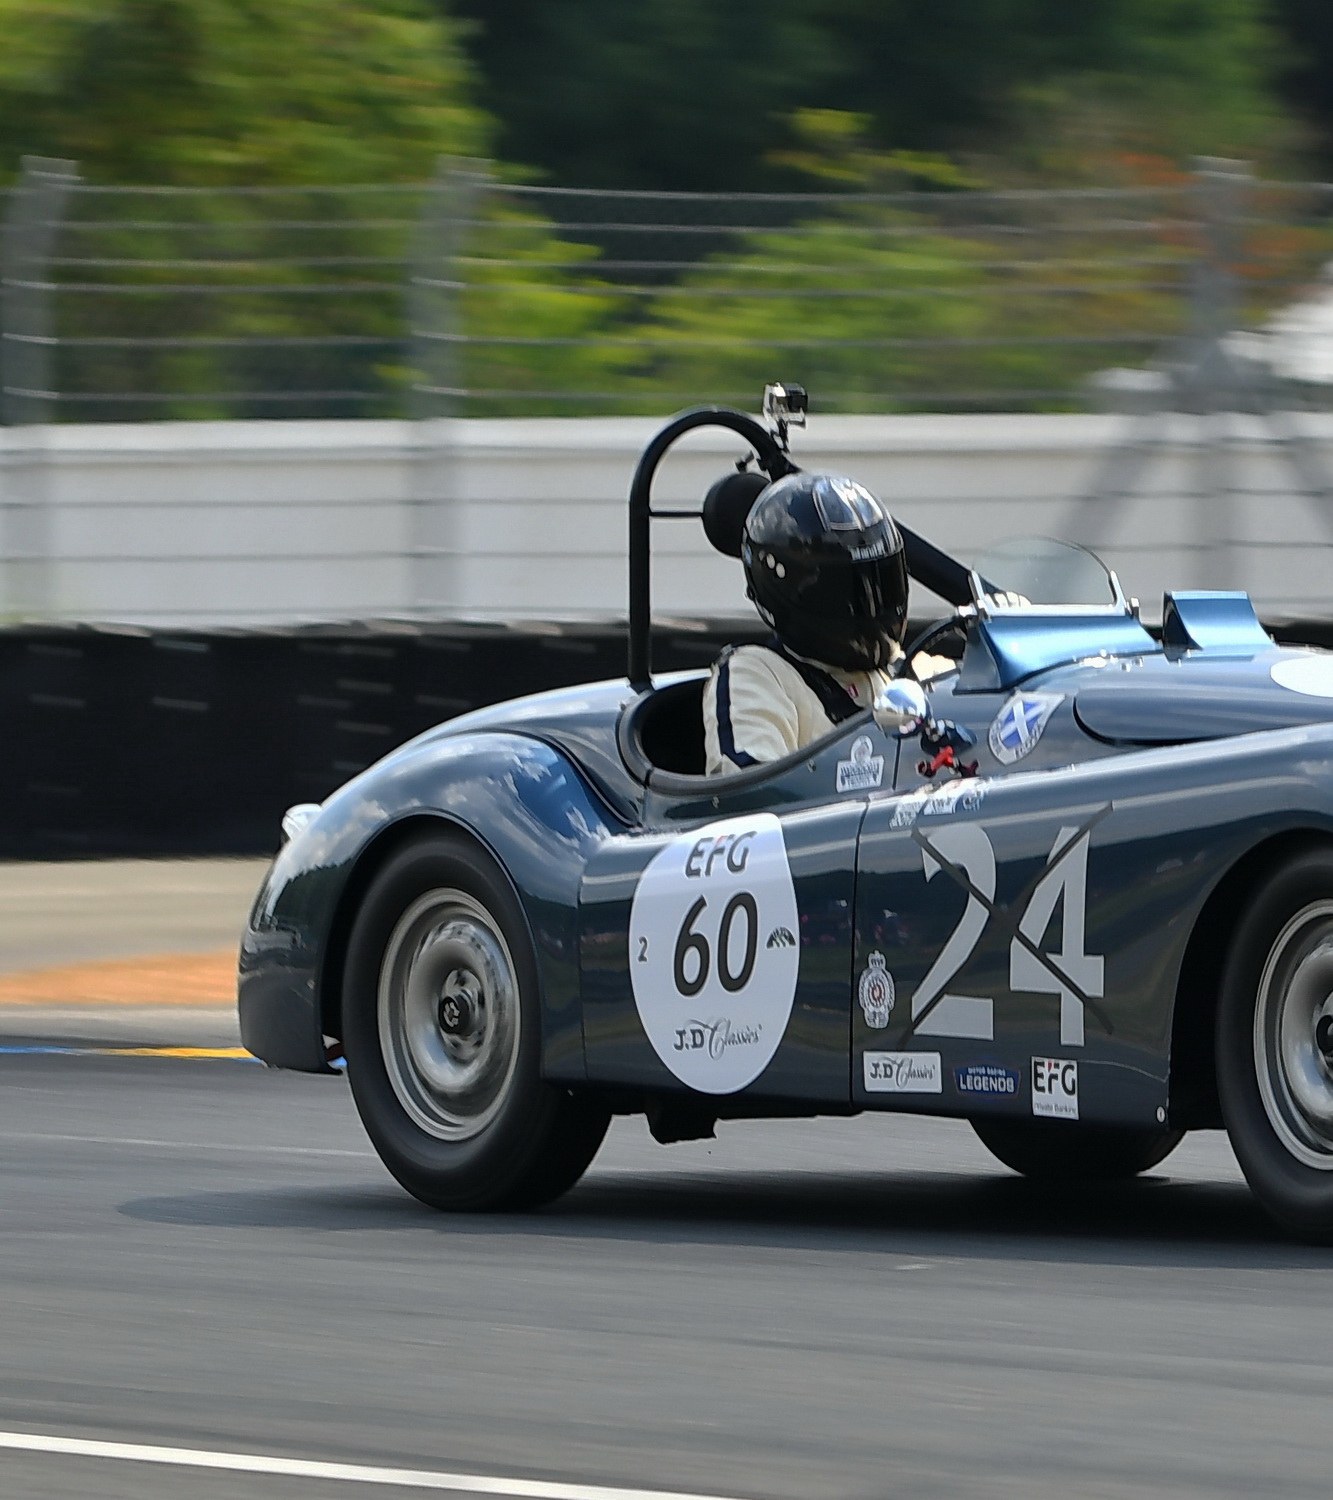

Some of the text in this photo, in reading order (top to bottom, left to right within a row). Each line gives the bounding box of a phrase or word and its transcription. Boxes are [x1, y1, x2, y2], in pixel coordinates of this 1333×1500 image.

[685, 831, 758, 878] EFG
[638, 936, 648, 962] 2
[674, 891, 758, 998] 60
[911, 825, 1105, 1047] 24
[959, 1074, 1016, 1093] LEGENDS
[1033, 1061, 1077, 1096] EFG
